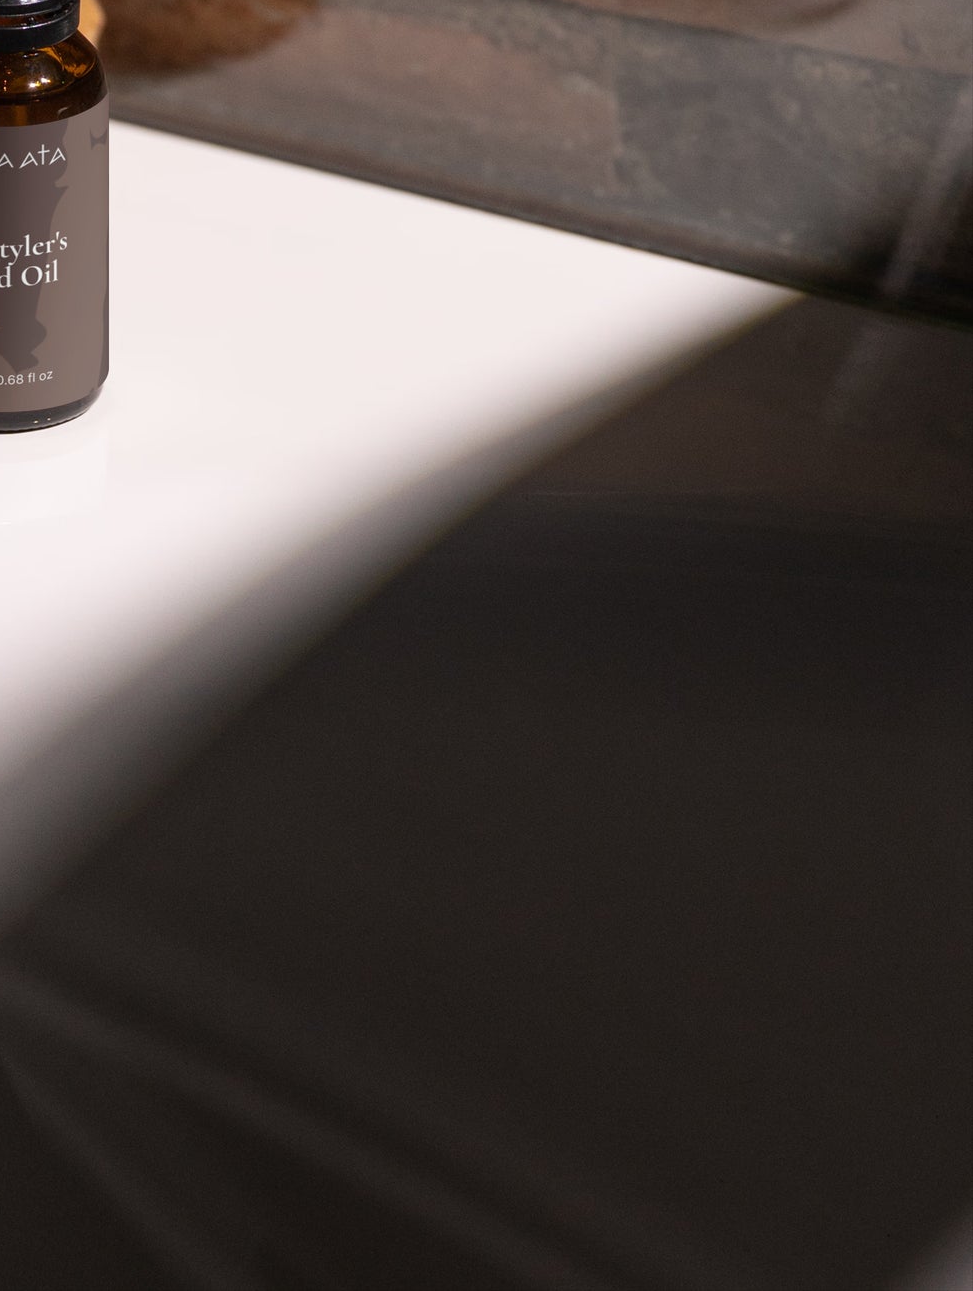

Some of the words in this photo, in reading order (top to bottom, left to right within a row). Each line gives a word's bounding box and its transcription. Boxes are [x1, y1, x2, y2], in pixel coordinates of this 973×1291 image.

[21, 259, 59, 287] Oil
[27, 372, 36, 384] fl
[39, 370, 54, 381] oz
